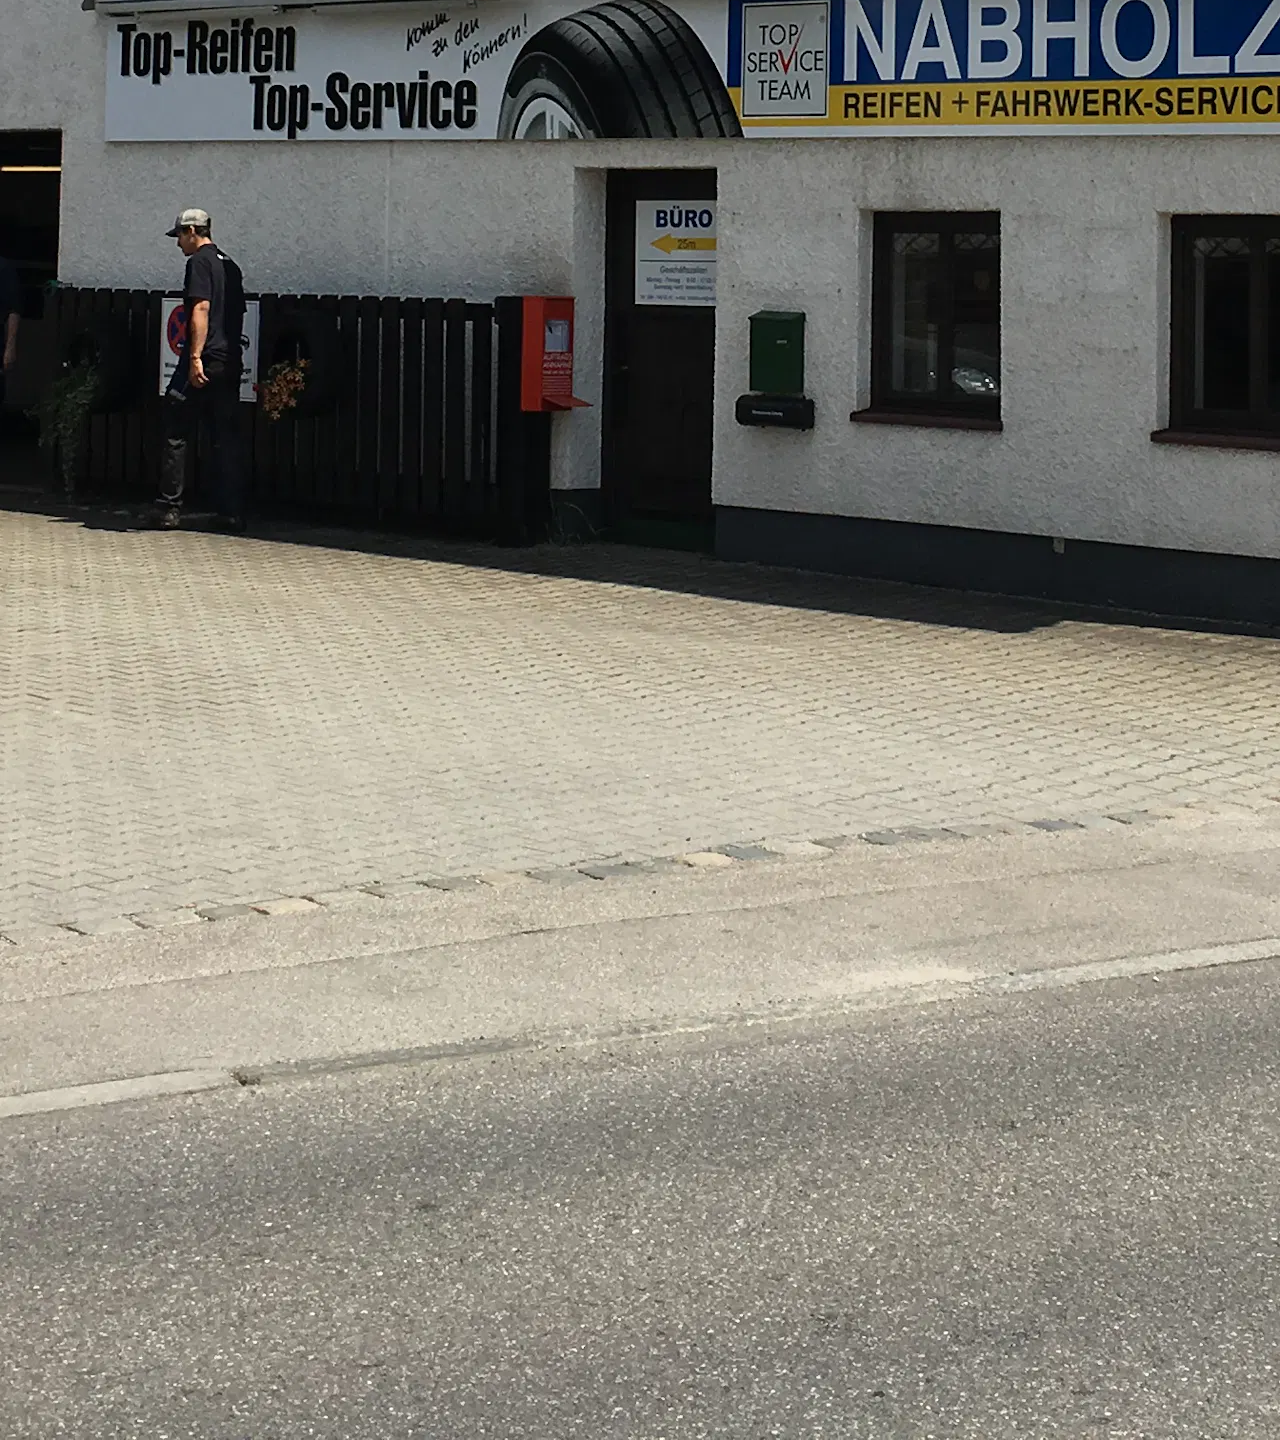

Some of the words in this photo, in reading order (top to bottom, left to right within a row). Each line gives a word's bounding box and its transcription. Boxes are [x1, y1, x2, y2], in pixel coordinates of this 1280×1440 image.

[431, 37, 449, 57] zu
[454, 18, 480, 46] den
[758, 24, 799, 45] TOP
[117, 19, 296, 85] Top-Reifen
[747, 49, 824, 74] SERVICE
[757, 80, 811, 101] TEAM
[250, 70, 478, 139] Top-Service
[843, 91, 942, 119] REIFEN
[655, 205, 713, 228] BÜRO
[677, 238, 697, 250] 25m
